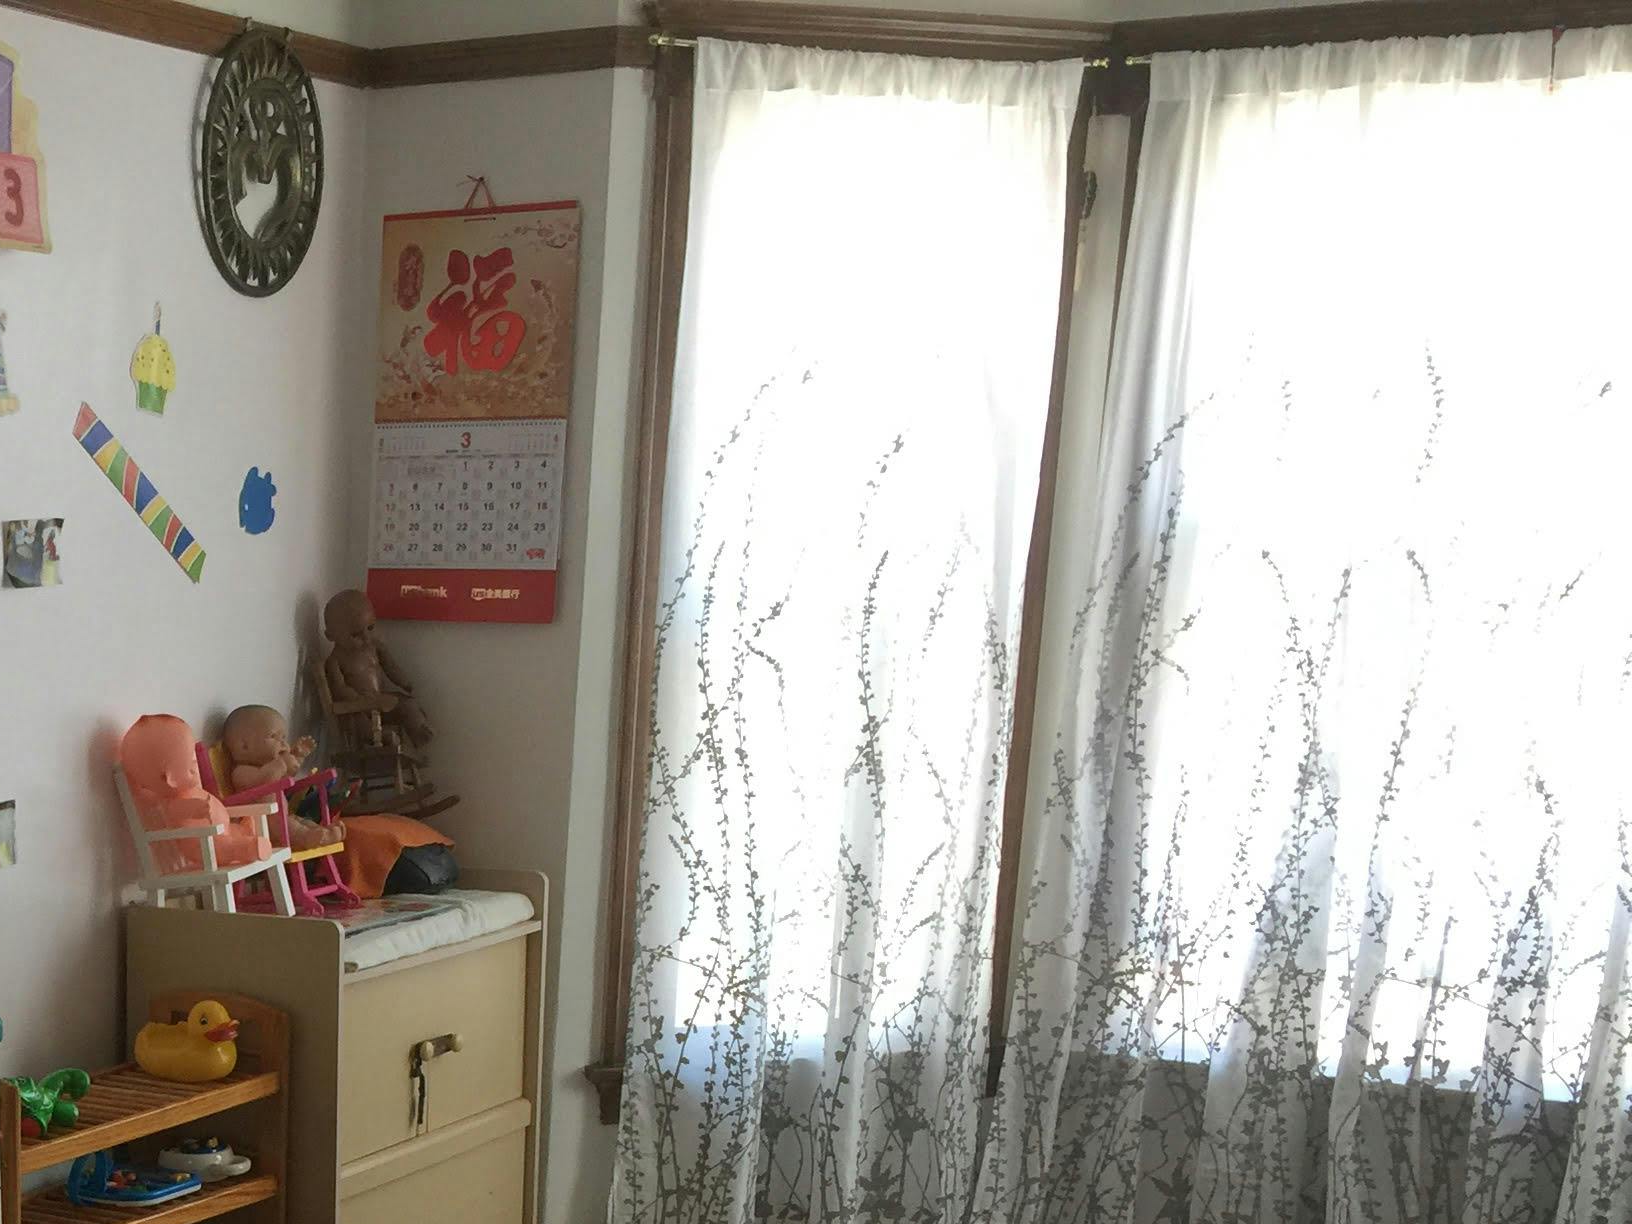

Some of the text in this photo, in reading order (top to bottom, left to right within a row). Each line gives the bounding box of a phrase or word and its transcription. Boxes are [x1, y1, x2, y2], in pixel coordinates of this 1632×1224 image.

[3, 168, 24, 227] 3
[424, 247, 526, 377] 福
[460, 432, 472, 449] 3
[510, 482, 522, 490] 10
[537, 481, 547, 489] 11
[409, 503, 421, 511] 13
[434, 503, 444, 511] 14
[509, 502, 520, 510] 17
[408, 523, 420, 531] 20
[433, 523, 443, 531] 21
[456, 522, 468, 531] 22
[481, 523, 493, 531] 23
[507, 523, 519, 531] 24
[533, 523, 546, 531] 25
[408, 543, 418, 552] 27
[432, 543, 443, 552] 28
[456, 543, 467, 552] 29
[506, 543, 517, 552] 31
